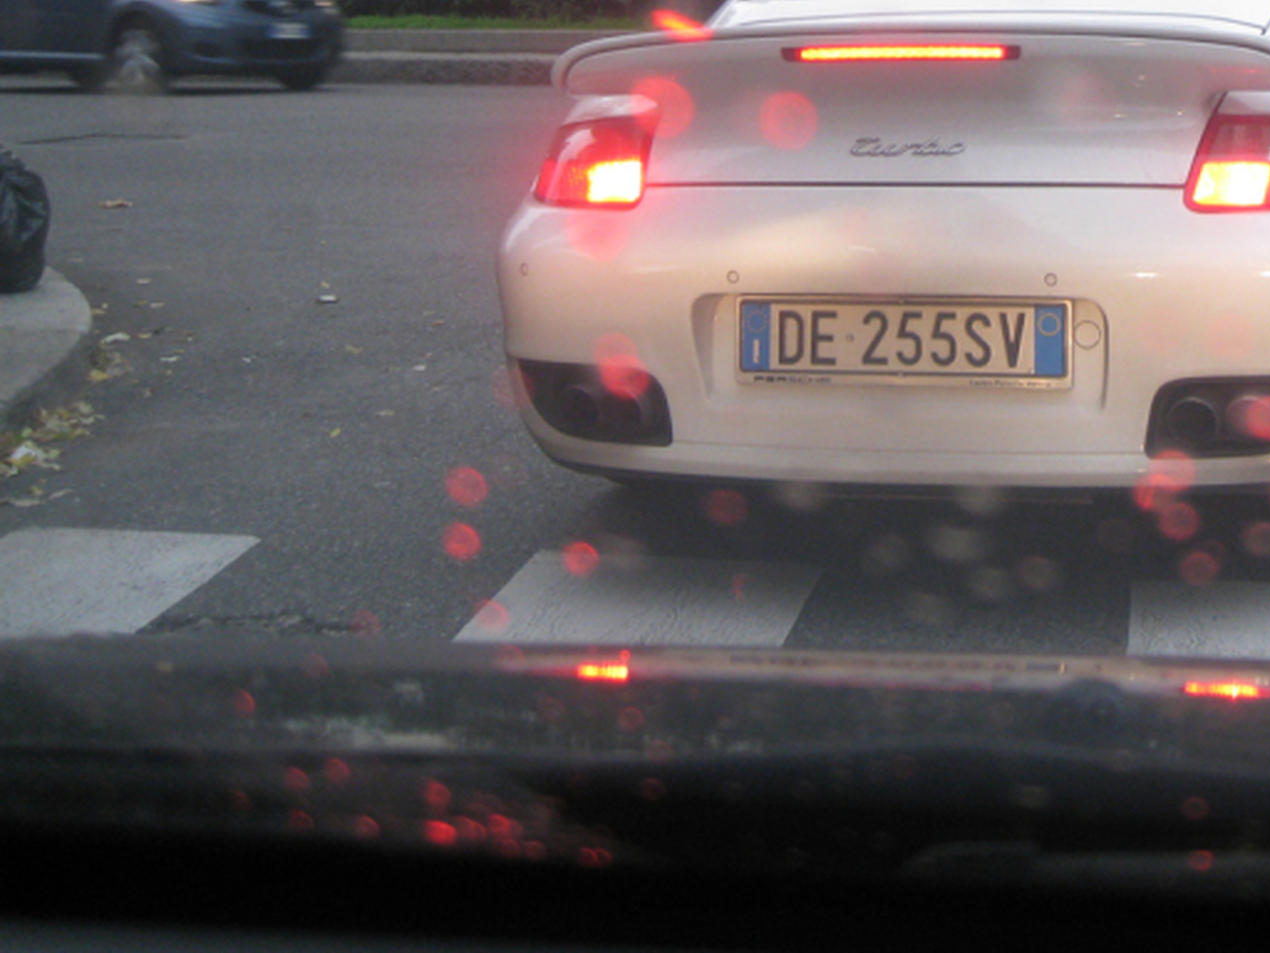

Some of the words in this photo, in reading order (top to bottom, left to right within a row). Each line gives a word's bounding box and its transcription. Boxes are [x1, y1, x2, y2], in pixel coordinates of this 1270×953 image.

[849, 136, 967, 157] Turbo
[778, 310, 838, 365] DE
[862, 311, 1026, 368] 255SV
